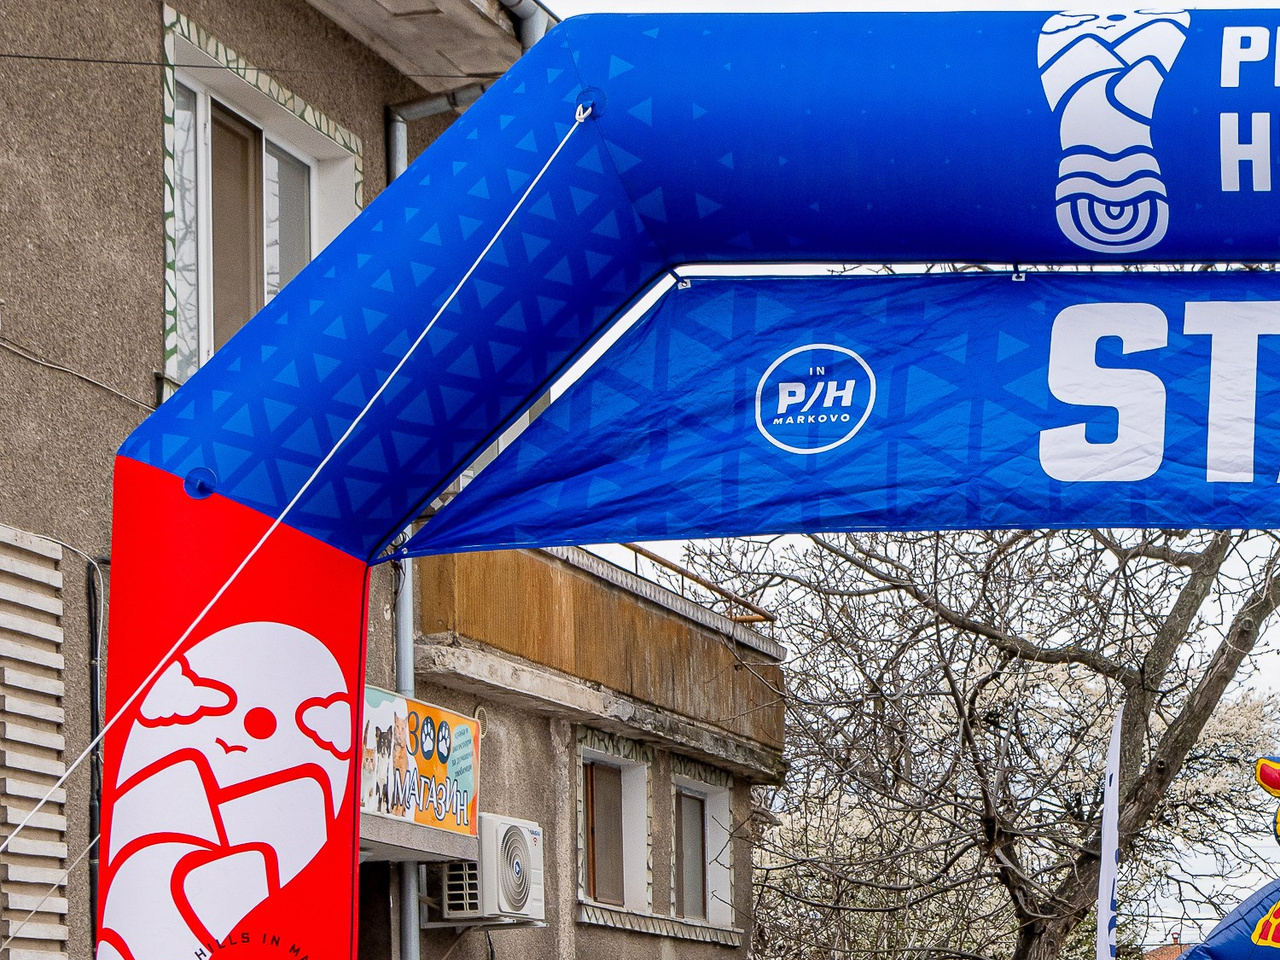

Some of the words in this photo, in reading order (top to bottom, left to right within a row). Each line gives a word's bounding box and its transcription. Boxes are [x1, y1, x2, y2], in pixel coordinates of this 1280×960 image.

[809, 366, 826, 376] IN
[777, 379, 856, 414] P/H
[773, 413, 852, 426] MARKOVO
[393, 767, 470, 827] МАГАЗИН
[194, 933, 251, 960] HILLS
[262, 933, 281, 946] IN
